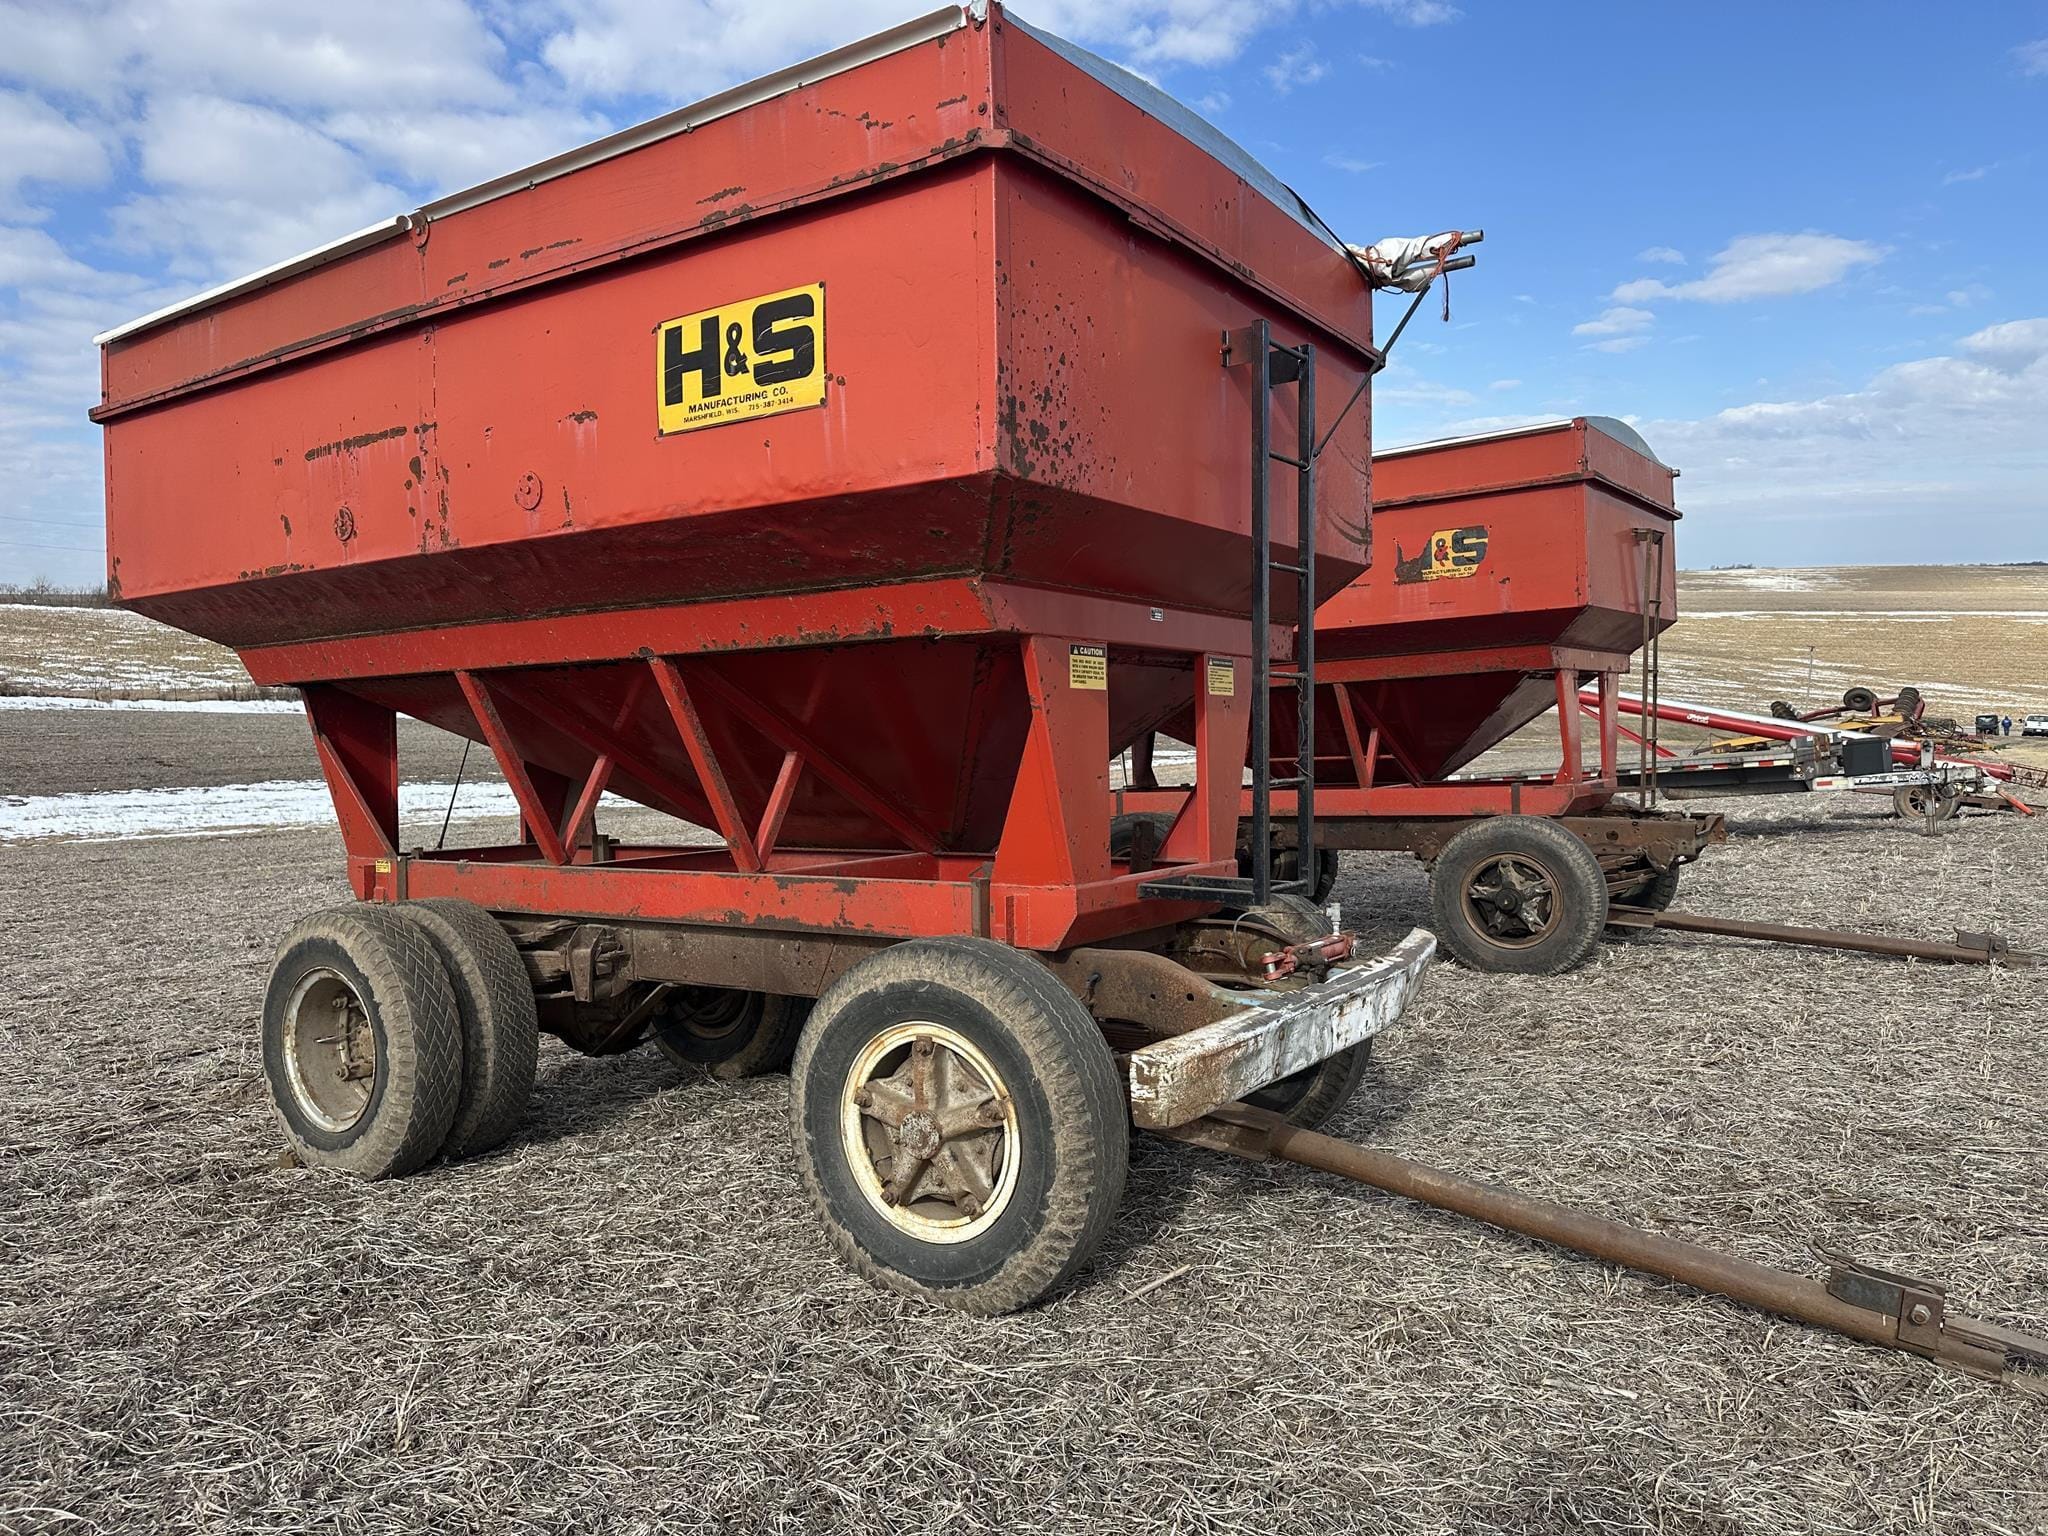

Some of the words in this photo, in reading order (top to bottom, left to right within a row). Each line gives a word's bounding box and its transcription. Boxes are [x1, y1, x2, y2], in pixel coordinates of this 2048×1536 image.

[664, 294, 815, 407] H&S
[688, 390, 768, 414] MANUFACTURING
[772, 386, 789, 397] CO.
[748, 396, 794, 411] 715-387-3414
[1080, 646, 1103, 656] CAUTION
